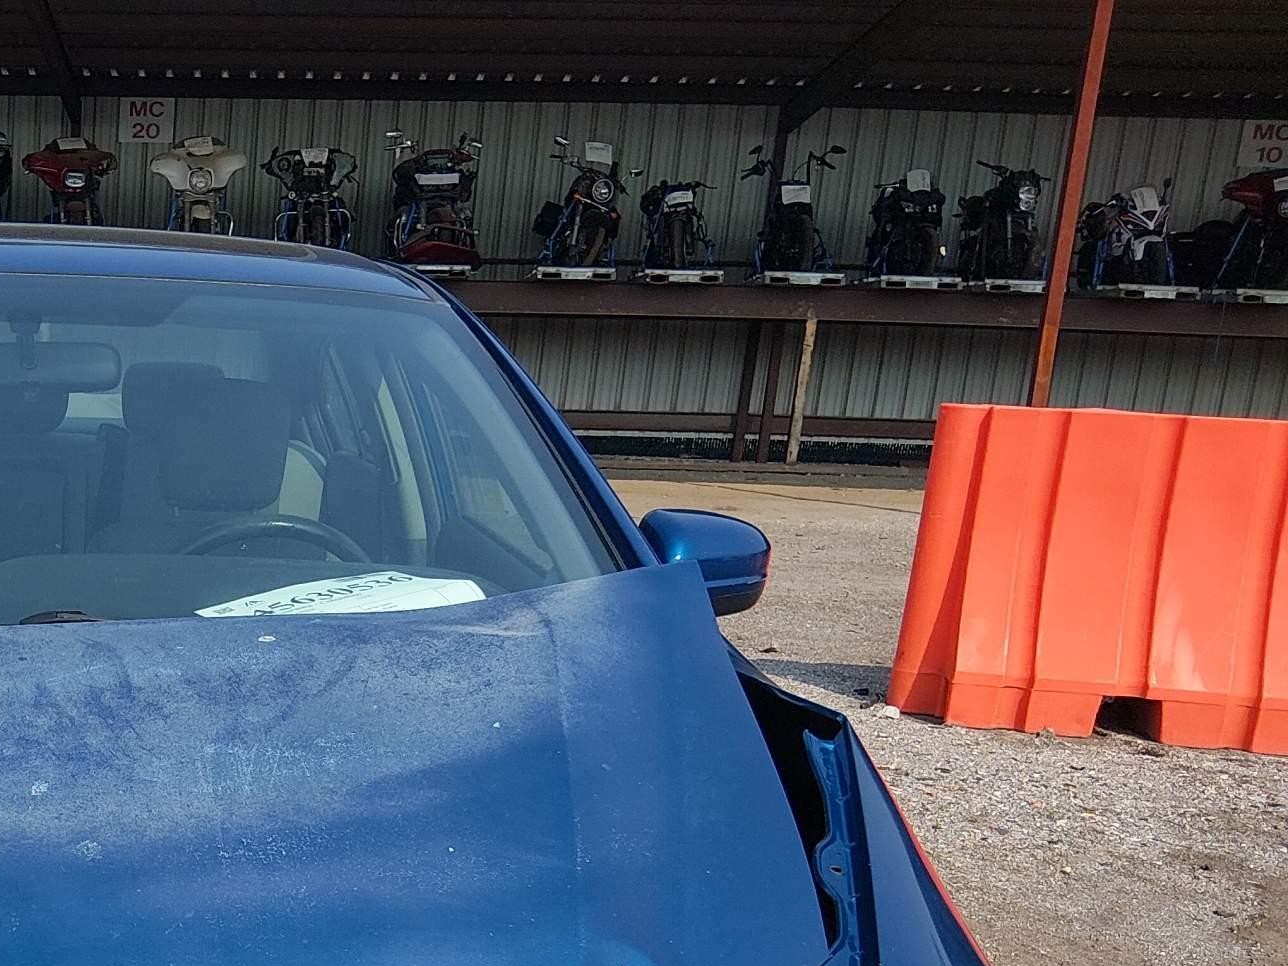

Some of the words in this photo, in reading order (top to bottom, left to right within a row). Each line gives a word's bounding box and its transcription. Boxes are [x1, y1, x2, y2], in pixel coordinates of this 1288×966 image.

[129, 100, 165, 118] MC
[131, 122, 161, 139] 20
[1252, 123, 1288, 140] MC
[1255, 146, 1283, 163] 10
